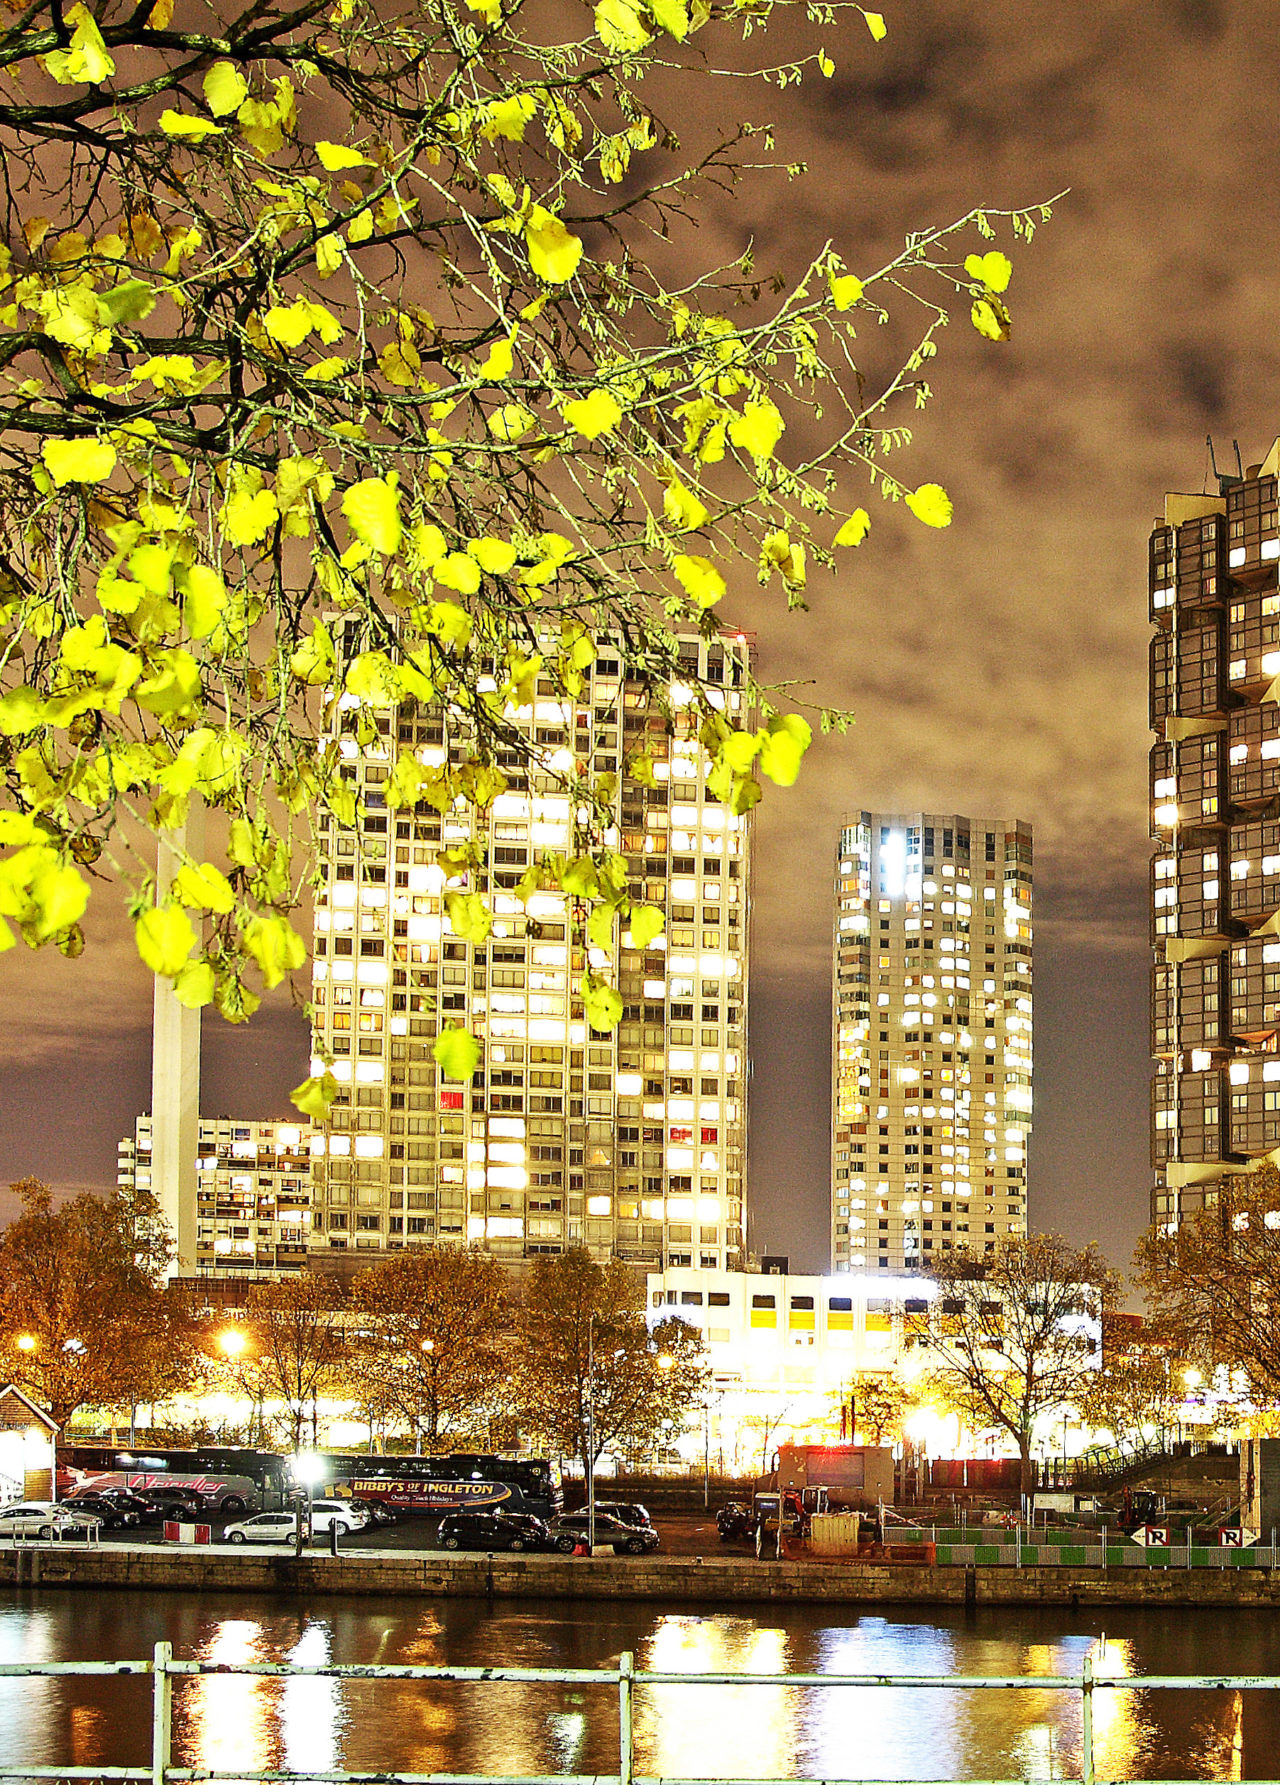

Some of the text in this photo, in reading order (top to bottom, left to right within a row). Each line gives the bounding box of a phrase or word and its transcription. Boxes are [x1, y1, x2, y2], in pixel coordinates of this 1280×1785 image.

[353, 1481, 494, 1495] BIBBY'S OF INGLETON
